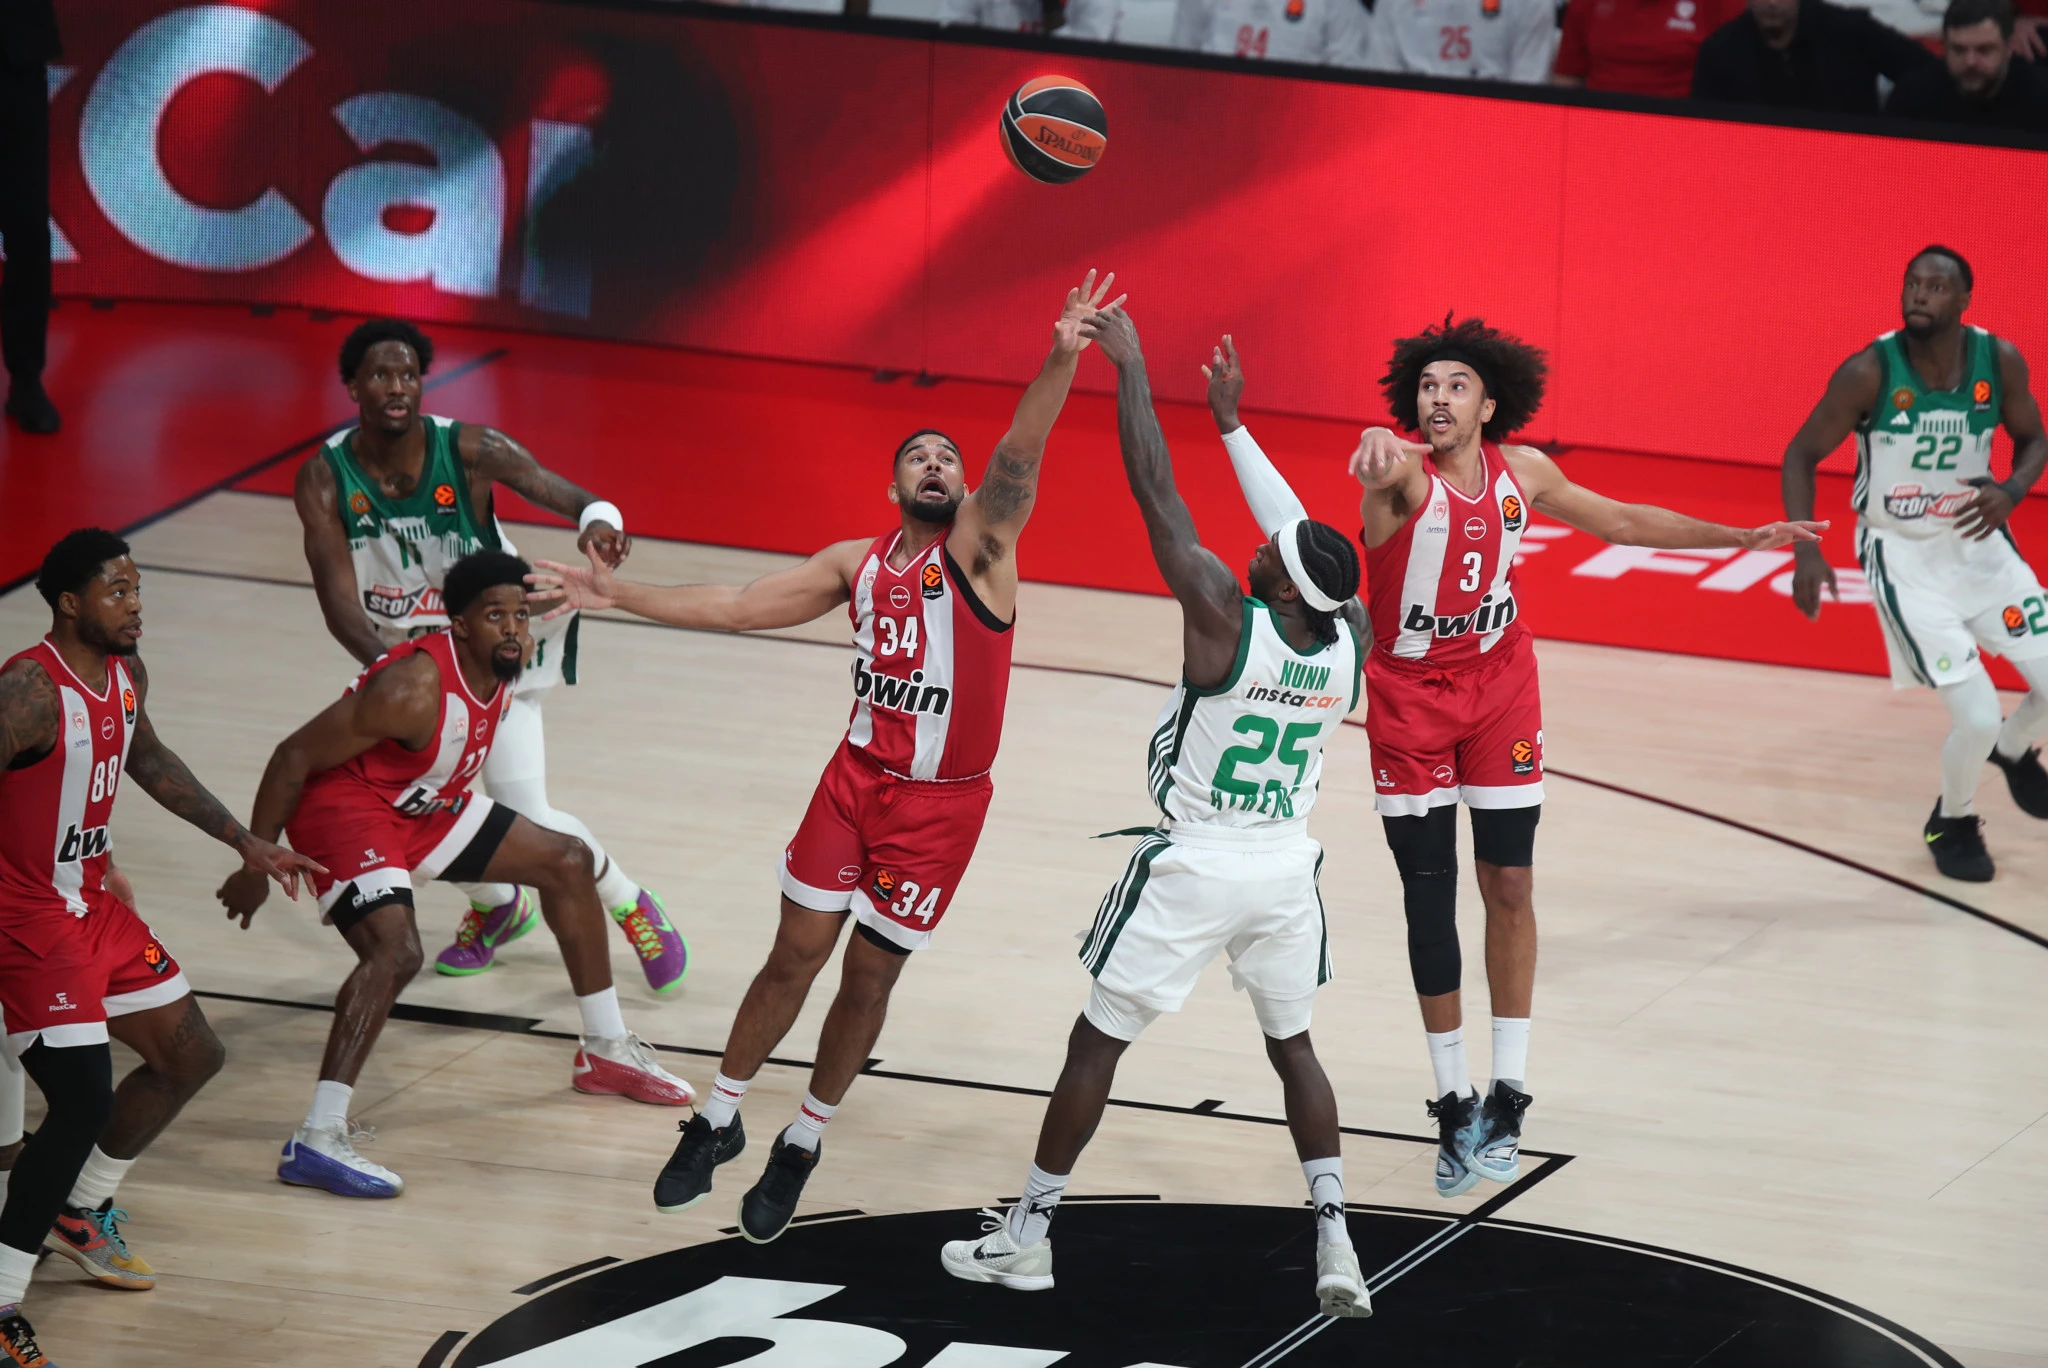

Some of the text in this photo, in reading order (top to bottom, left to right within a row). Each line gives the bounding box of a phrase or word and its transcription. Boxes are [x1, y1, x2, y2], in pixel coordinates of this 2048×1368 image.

[1440, 27, 1471, 60] 25
[1911, 435, 1963, 471] 22
[1460, 552, 1482, 592] 3
[1403, 594, 1516, 638] bwin
[2023, 594, 2048, 635] 2
[879, 616, 919, 658] 34
[854, 657, 950, 716] bwin
[1246, 681, 1343, 708] instacar
[1279, 660, 1331, 691] NUNN
[1212, 714, 1322, 796] 25
[91, 755, 119, 803] 88
[891, 881, 942, 925] 34
